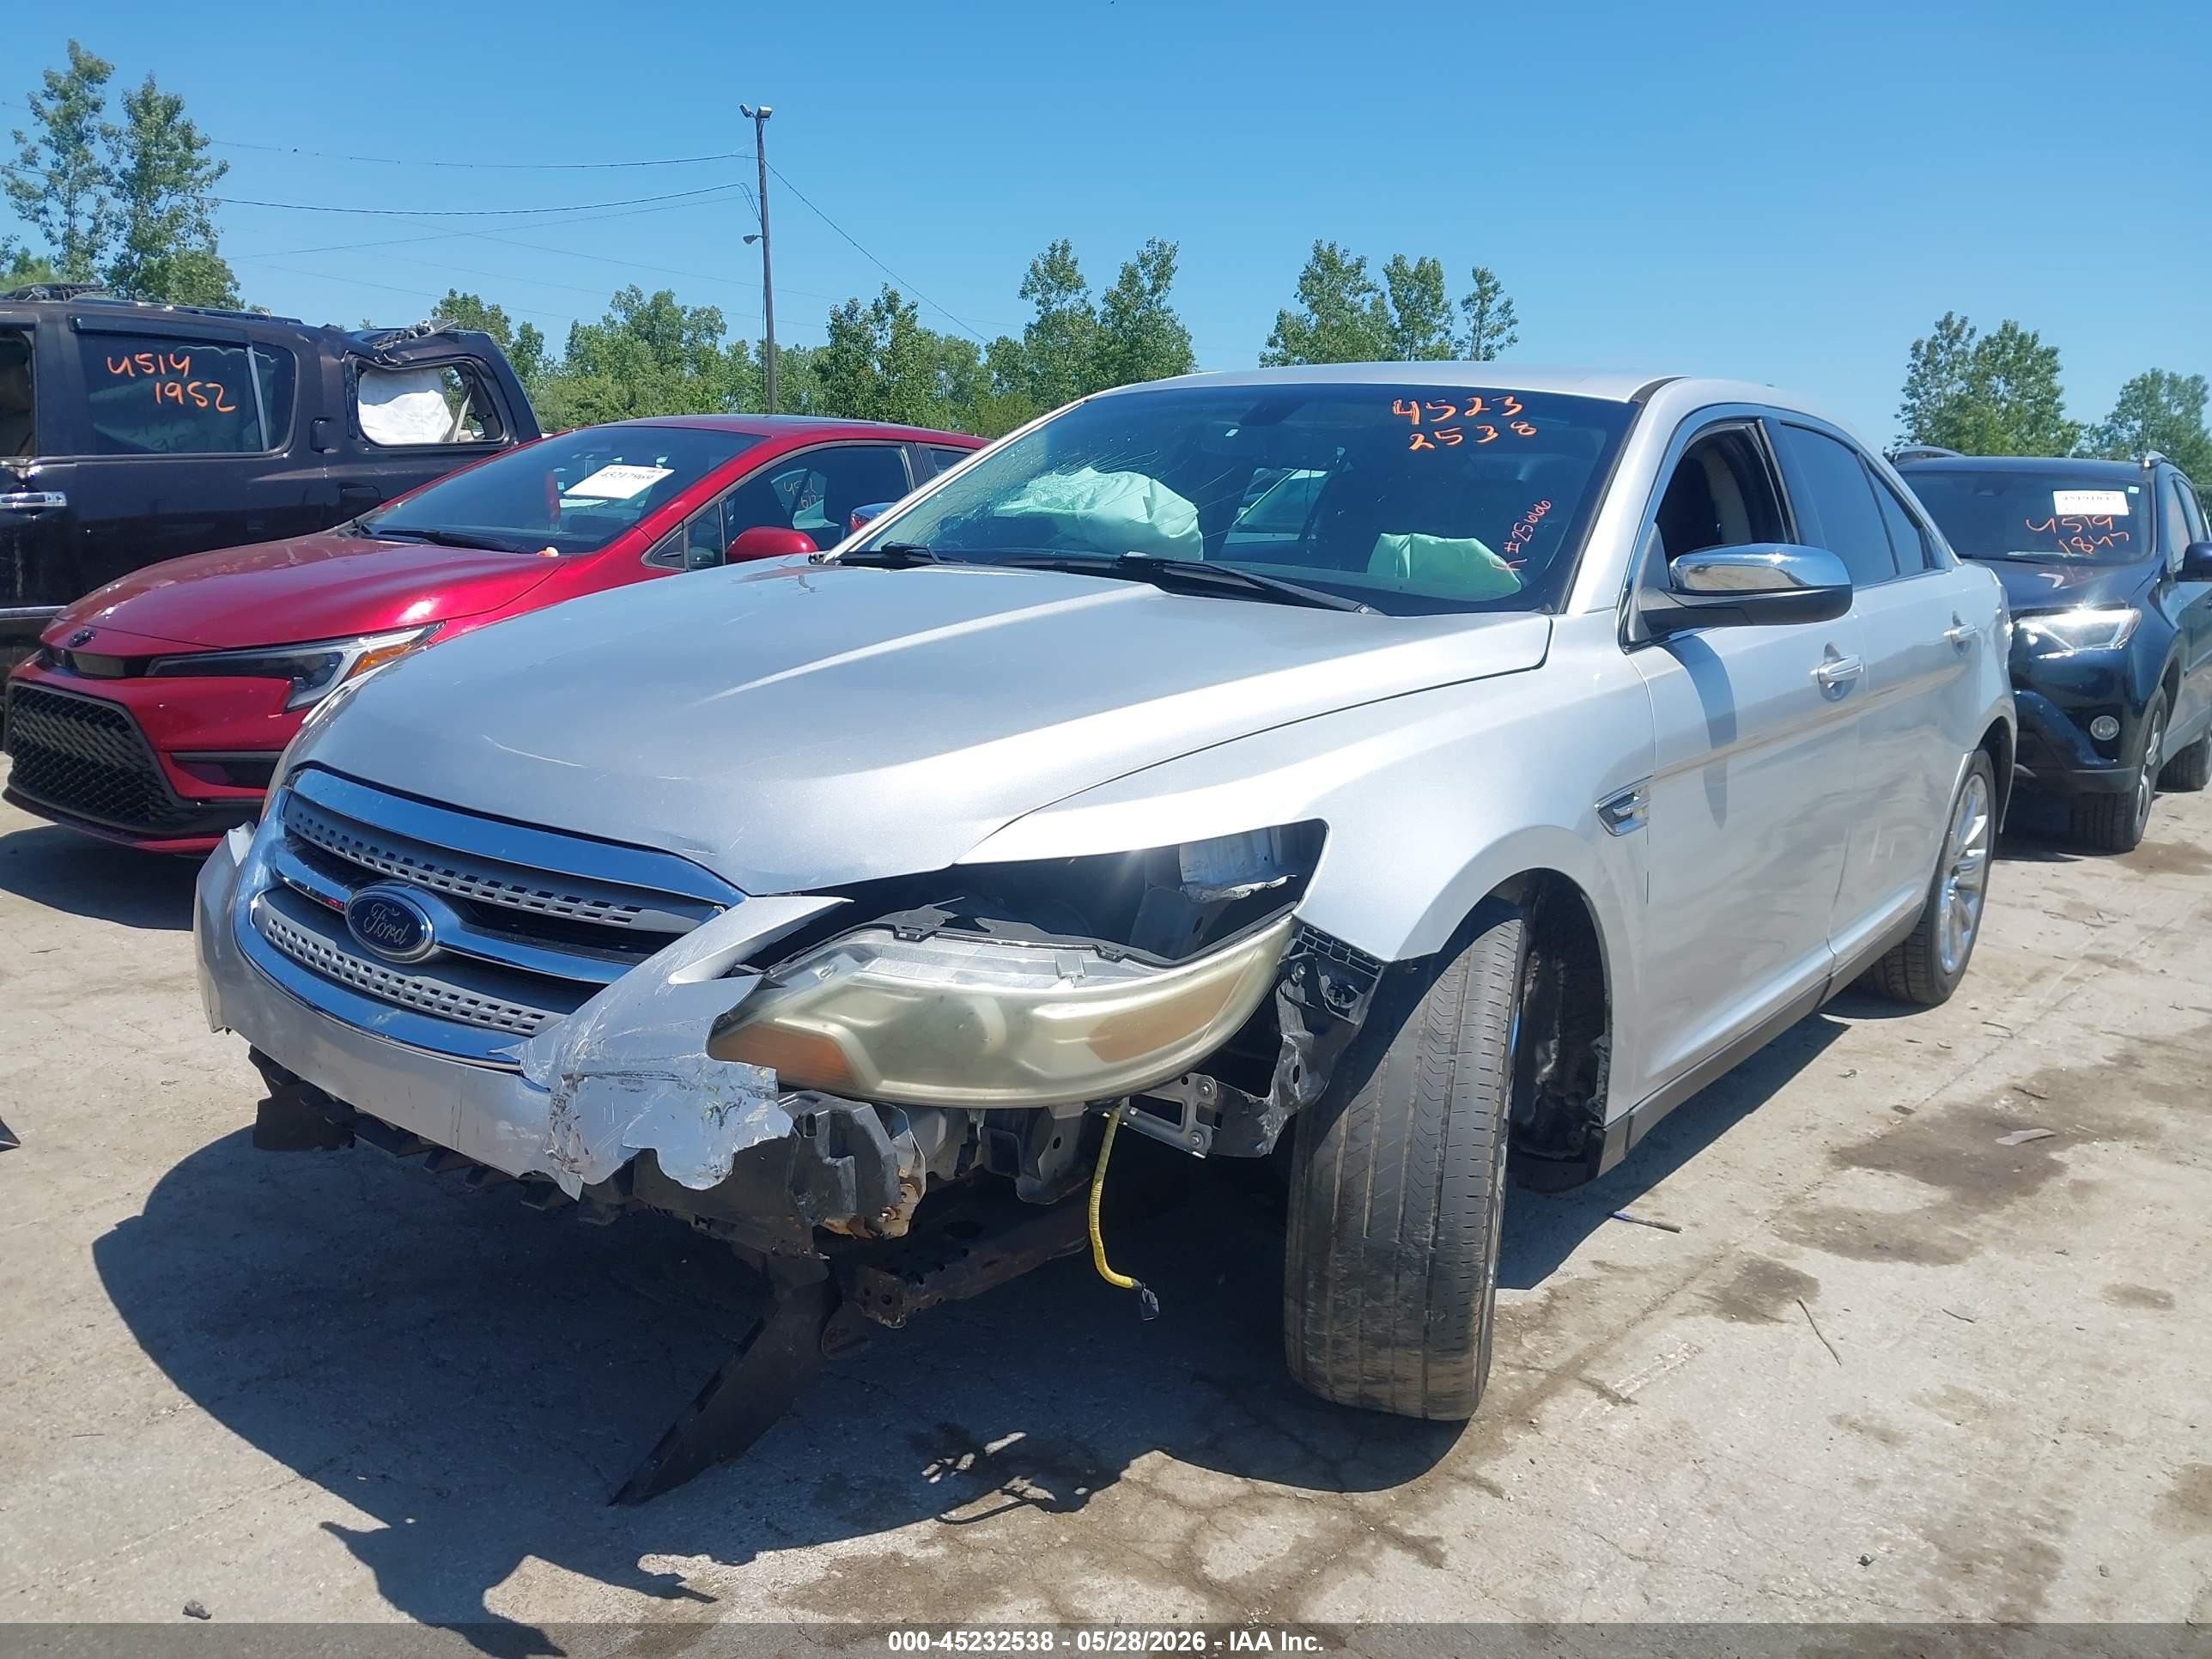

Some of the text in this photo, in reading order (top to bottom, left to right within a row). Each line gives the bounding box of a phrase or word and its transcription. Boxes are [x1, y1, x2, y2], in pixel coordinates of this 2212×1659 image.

[155, 380, 236, 412] 1952
[1393, 396, 1523, 426] 4523
[1408, 421, 1538, 451] 2538
[362, 902, 410, 945] Ford
